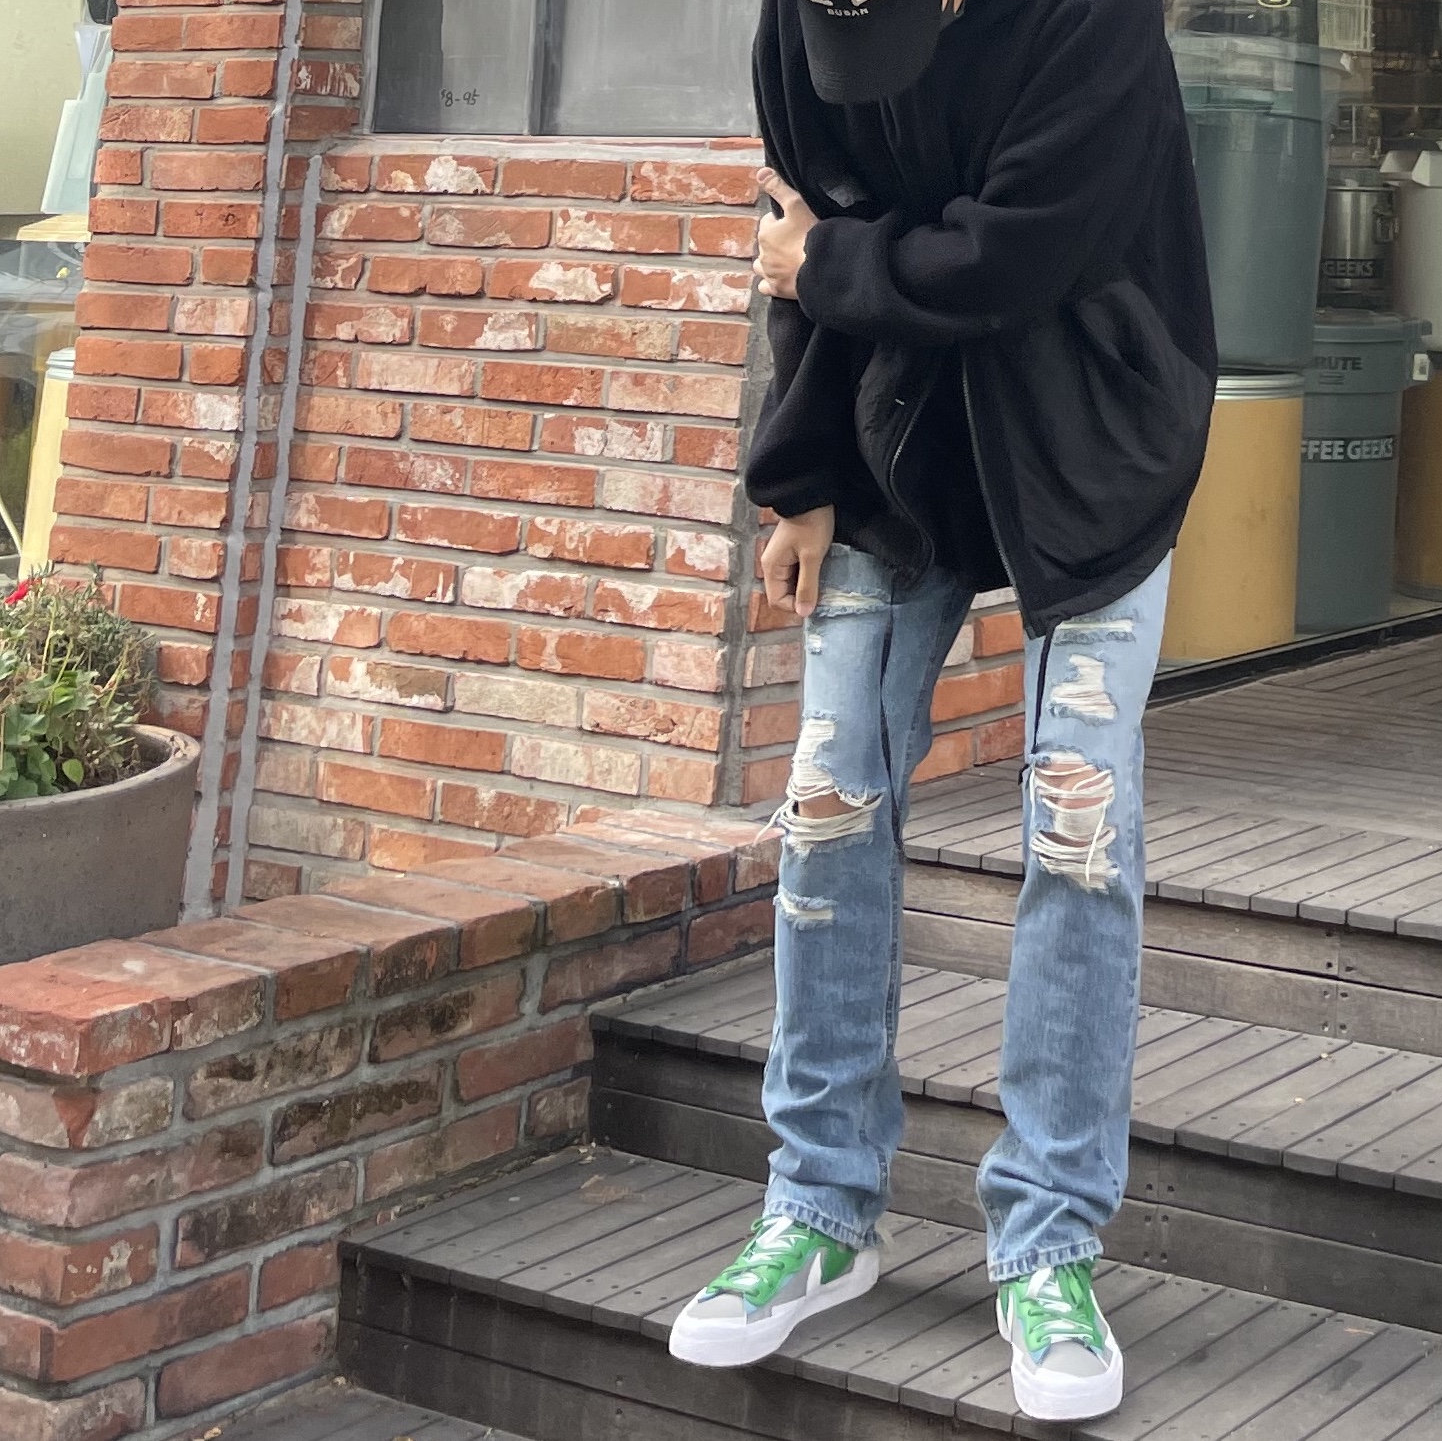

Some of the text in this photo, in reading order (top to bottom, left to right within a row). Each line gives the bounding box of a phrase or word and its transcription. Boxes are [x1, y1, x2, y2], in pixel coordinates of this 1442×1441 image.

[826, 8, 869, 17] BUSAN
[1323, 260, 1374, 277] GEEKS
[1310, 355, 1364, 371] RUTE
[1346, 438, 1394, 460] GEEKS
